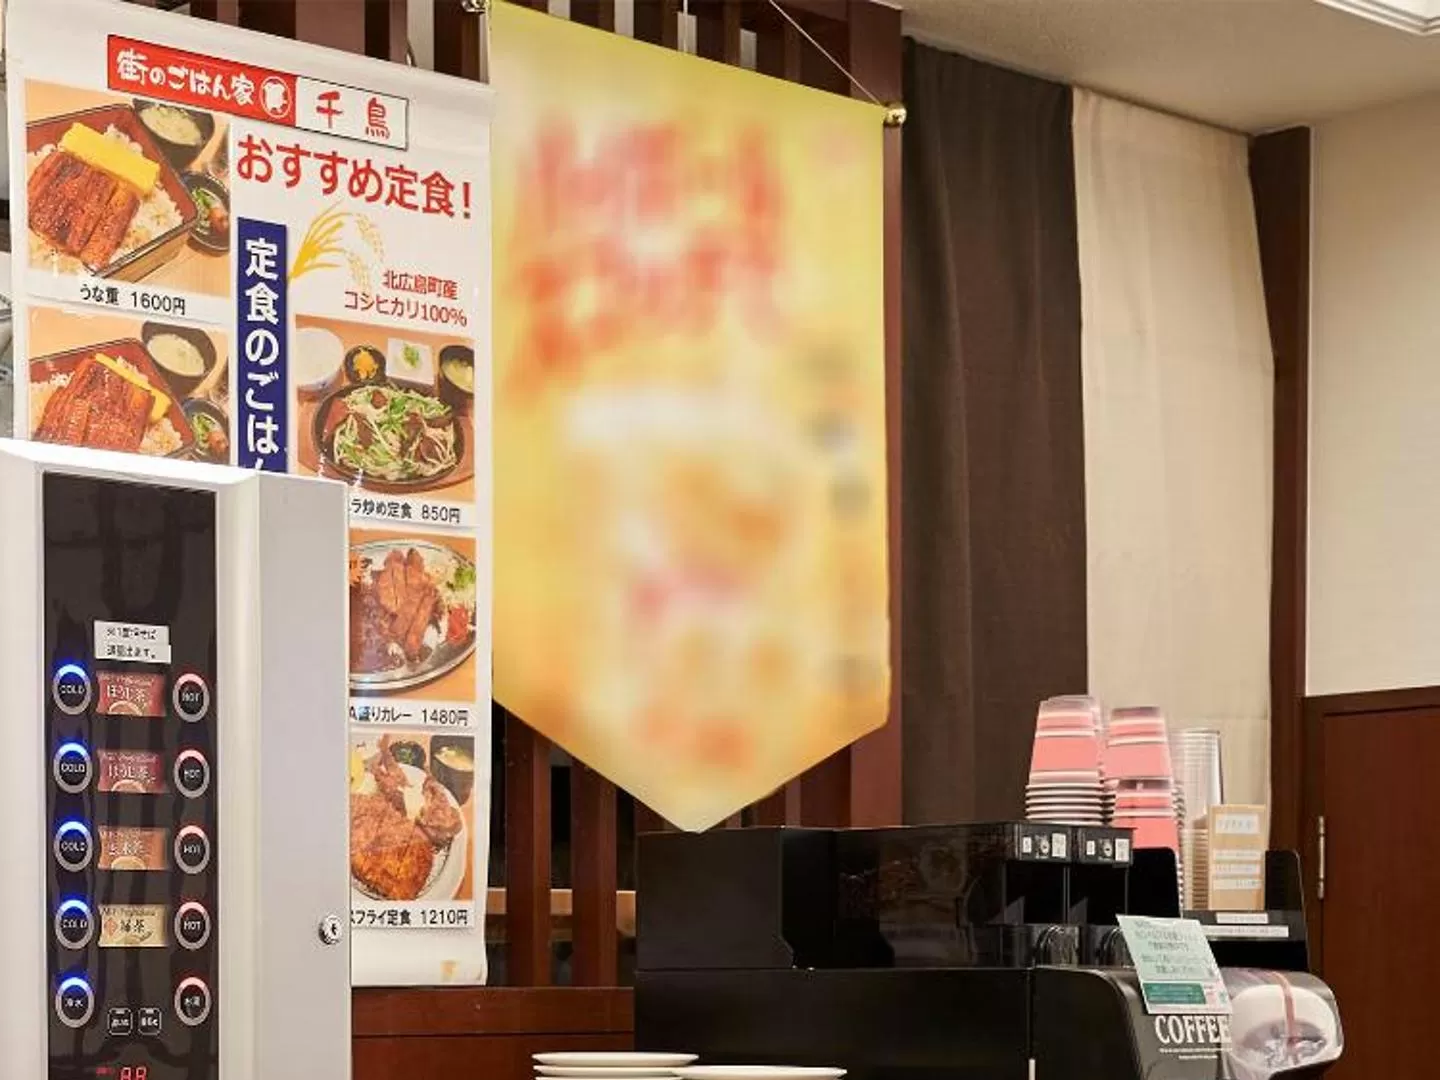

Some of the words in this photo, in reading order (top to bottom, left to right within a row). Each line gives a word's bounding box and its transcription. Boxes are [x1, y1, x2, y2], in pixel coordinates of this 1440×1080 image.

[116, 48, 256, 106] 街のごはん家
[79, 283, 119, 306] うな重
[131, 291, 185, 316] 1600円
[381, 270, 459, 300] 北広島町産
[244, 237, 279, 470] 定食のごは
[348, 498, 412, 519] ラ炒め定食
[421, 503, 461, 524] 850円
[421, 708, 468, 727] 1480円
[420, 908, 468, 926] 1210円
[1154, 1014, 1232, 1045] COFFEE
